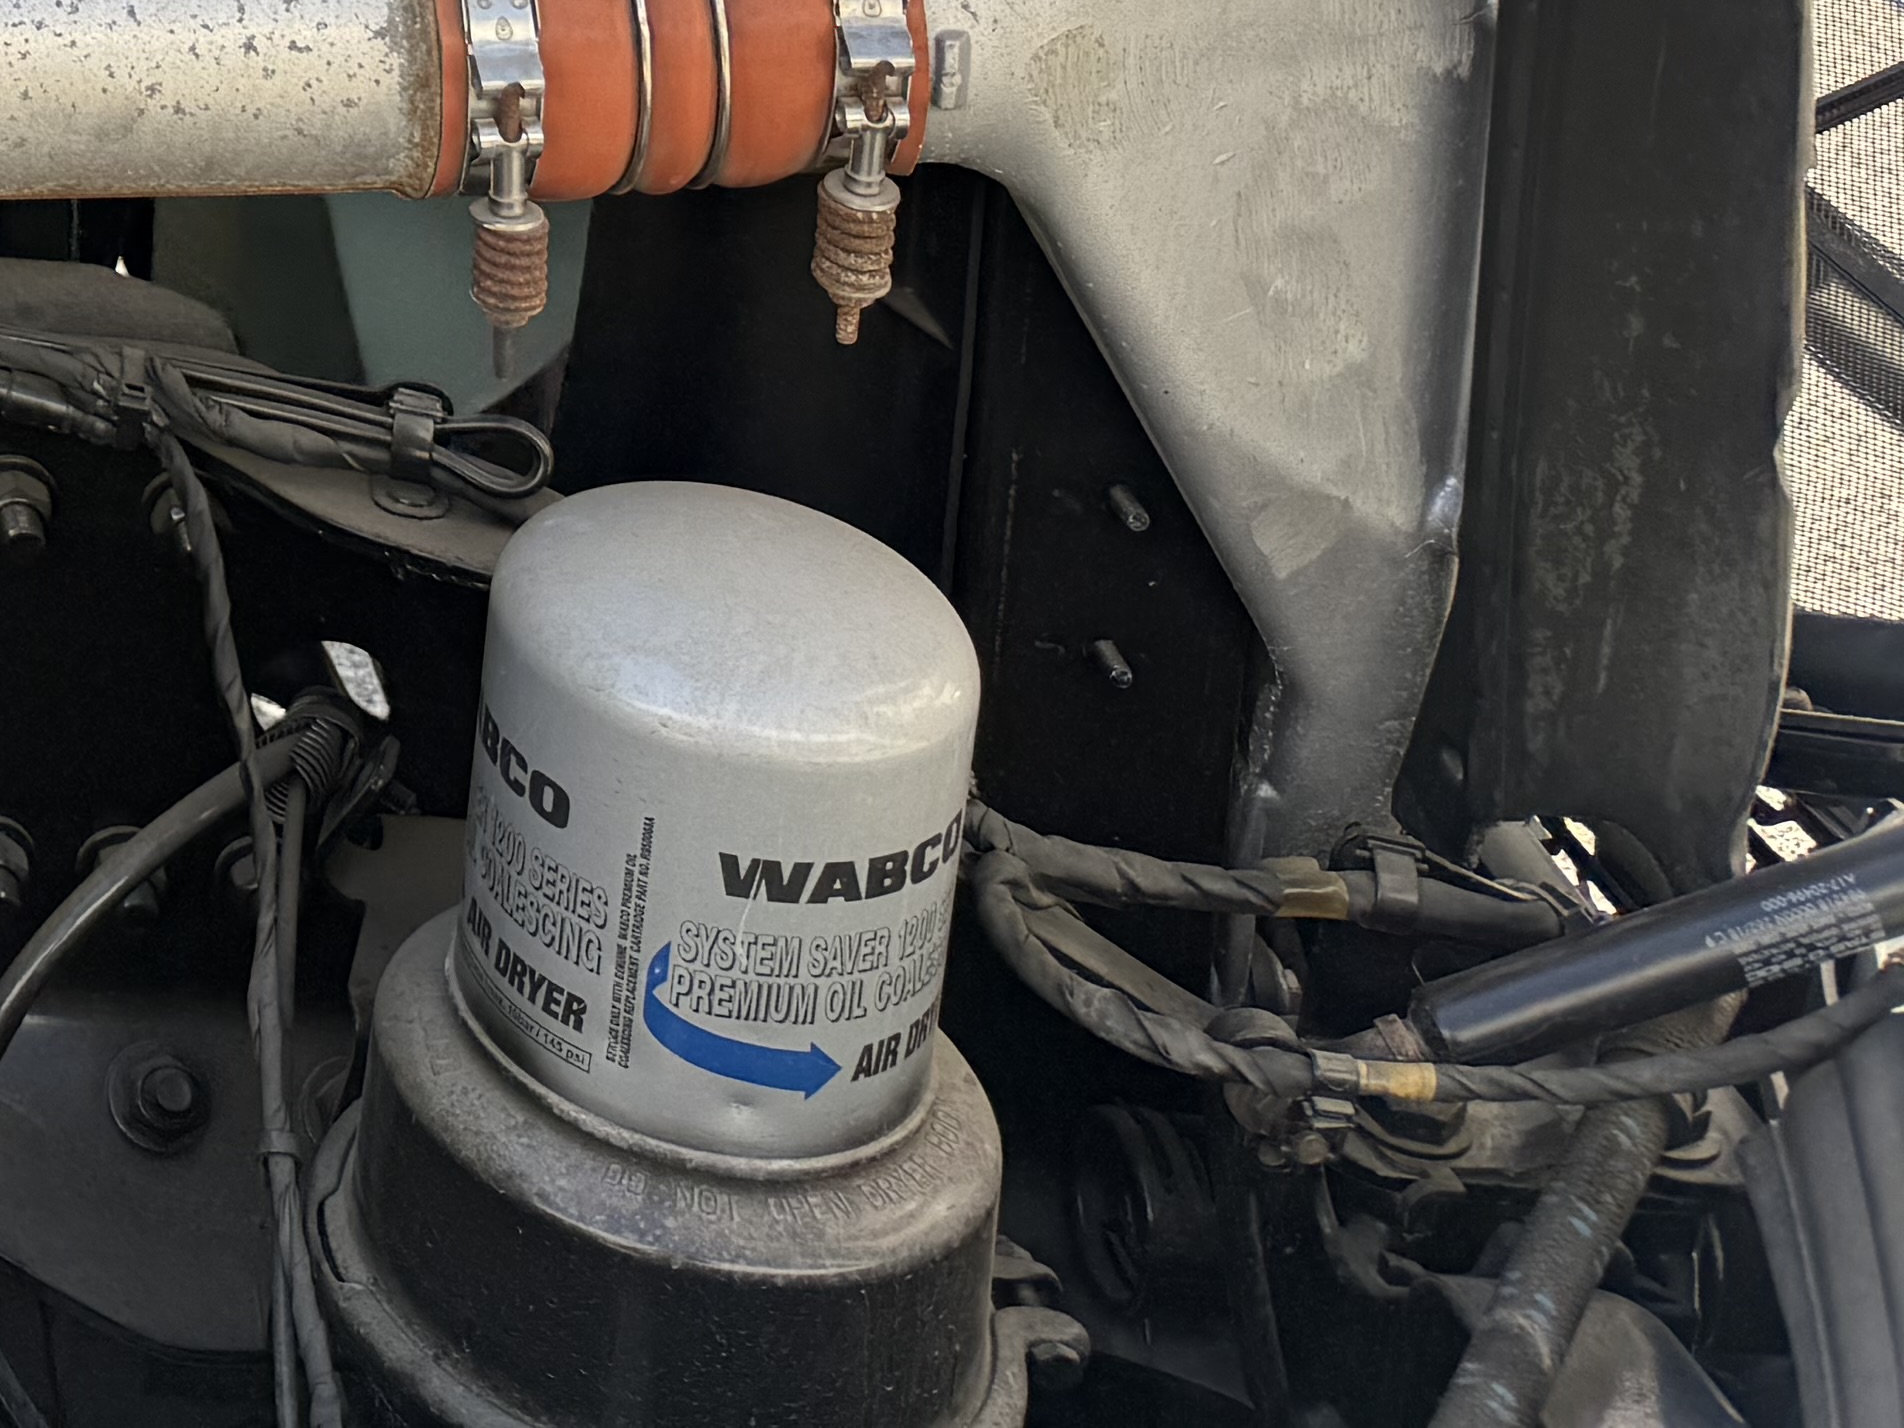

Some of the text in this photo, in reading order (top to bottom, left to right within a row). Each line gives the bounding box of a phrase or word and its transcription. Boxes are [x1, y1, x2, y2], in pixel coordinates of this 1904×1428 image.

[529, 847, 609, 930] SERIES
[718, 808, 964, 905] WABCO
[466, 896, 492, 960] AIR
[494, 938, 589, 1035] DRYER
[676, 919, 804, 979] SYSTEM
[806, 926, 892, 979] SAVER
[668, 964, 819, 1027] PREMIUM
[824, 980, 868, 1023] OIL
[565, 1045, 586, 1068] psi
[850, 1031, 903, 1083] AIR
[601, 1161, 648, 1196] DO
[674, 1186, 740, 1223] NOT
[859, 1153, 936, 1211] DRYER
